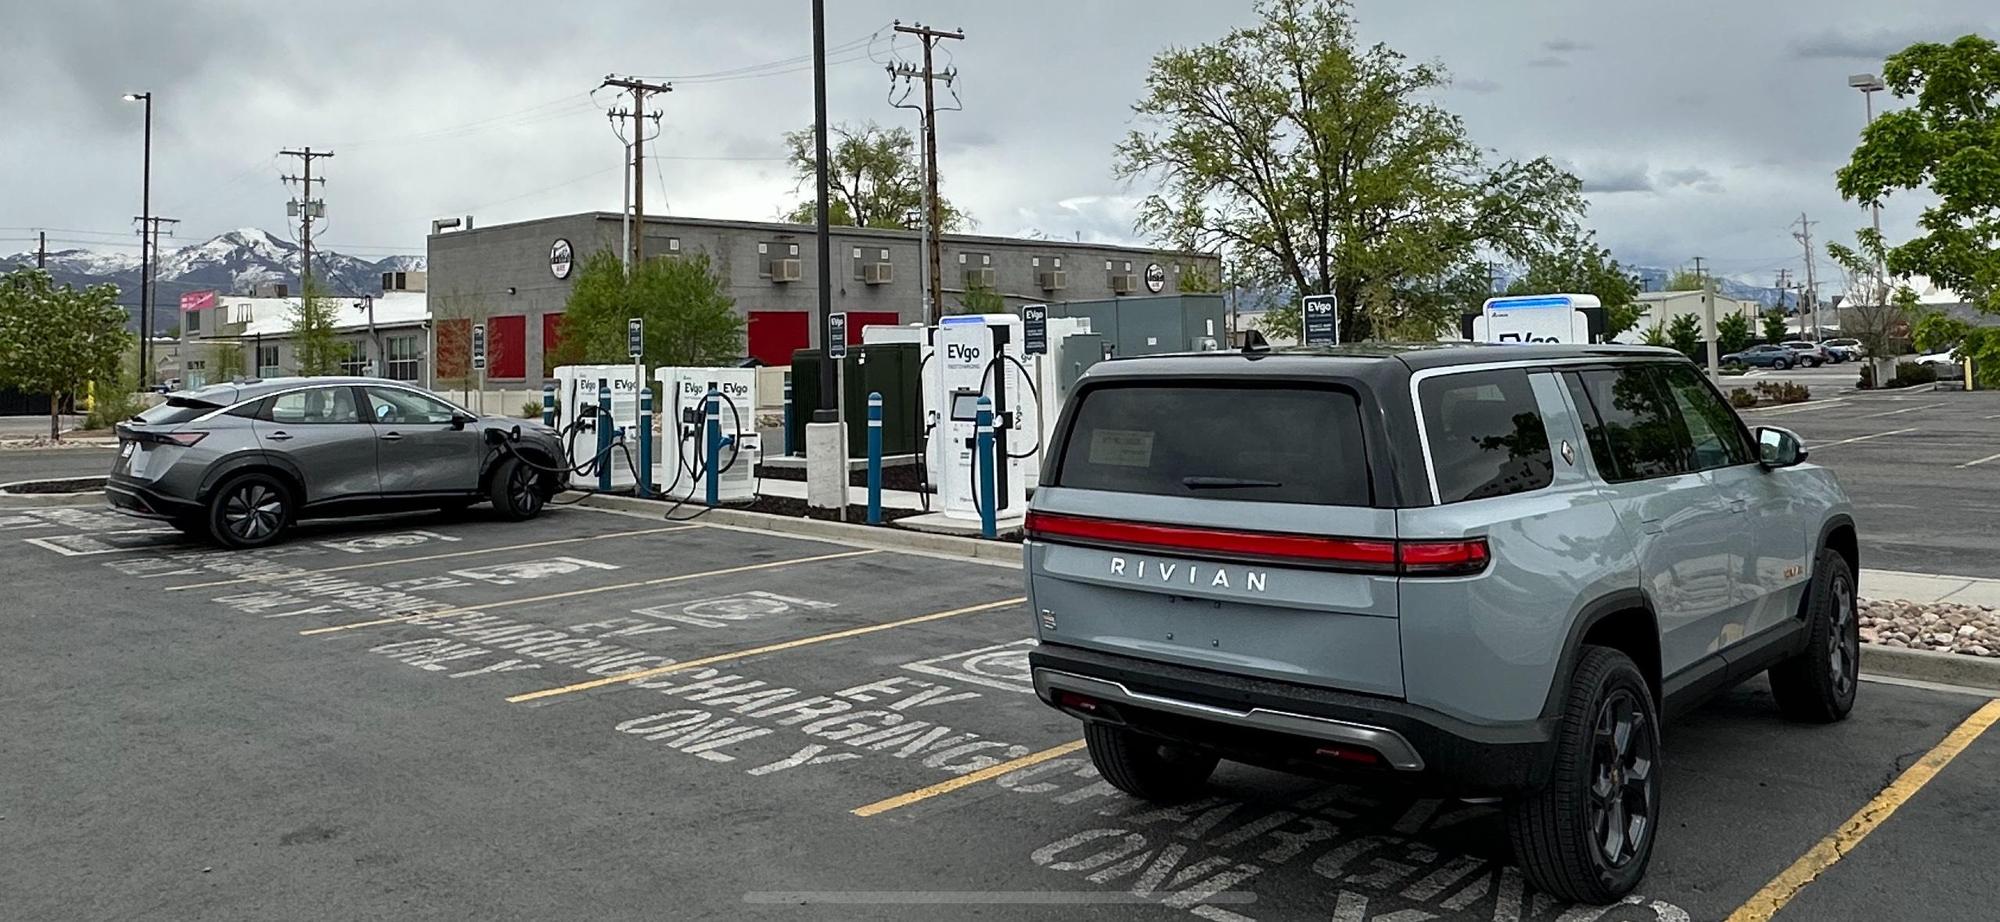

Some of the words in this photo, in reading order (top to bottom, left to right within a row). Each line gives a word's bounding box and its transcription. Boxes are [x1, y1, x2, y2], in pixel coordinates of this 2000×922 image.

[1026, 310, 1044, 321] EVgo
[1308, 301, 1332, 314] EVgo
[947, 343, 980, 363] EVgo
[580, 379, 597, 393] EVgo
[684, 382, 704, 397] EVgo
[723, 382, 748, 397] EVgo
[1015, 404, 1023, 431] EVgo
[1110, 556, 1269, 593] RIVIAN
[568, 616, 678, 639] EV
[368, 637, 543, 679] ONLY
[834, 676, 983, 711] EV
[627, 667, 1030, 774] CHARGING
[614, 708, 863, 777] ONLY
